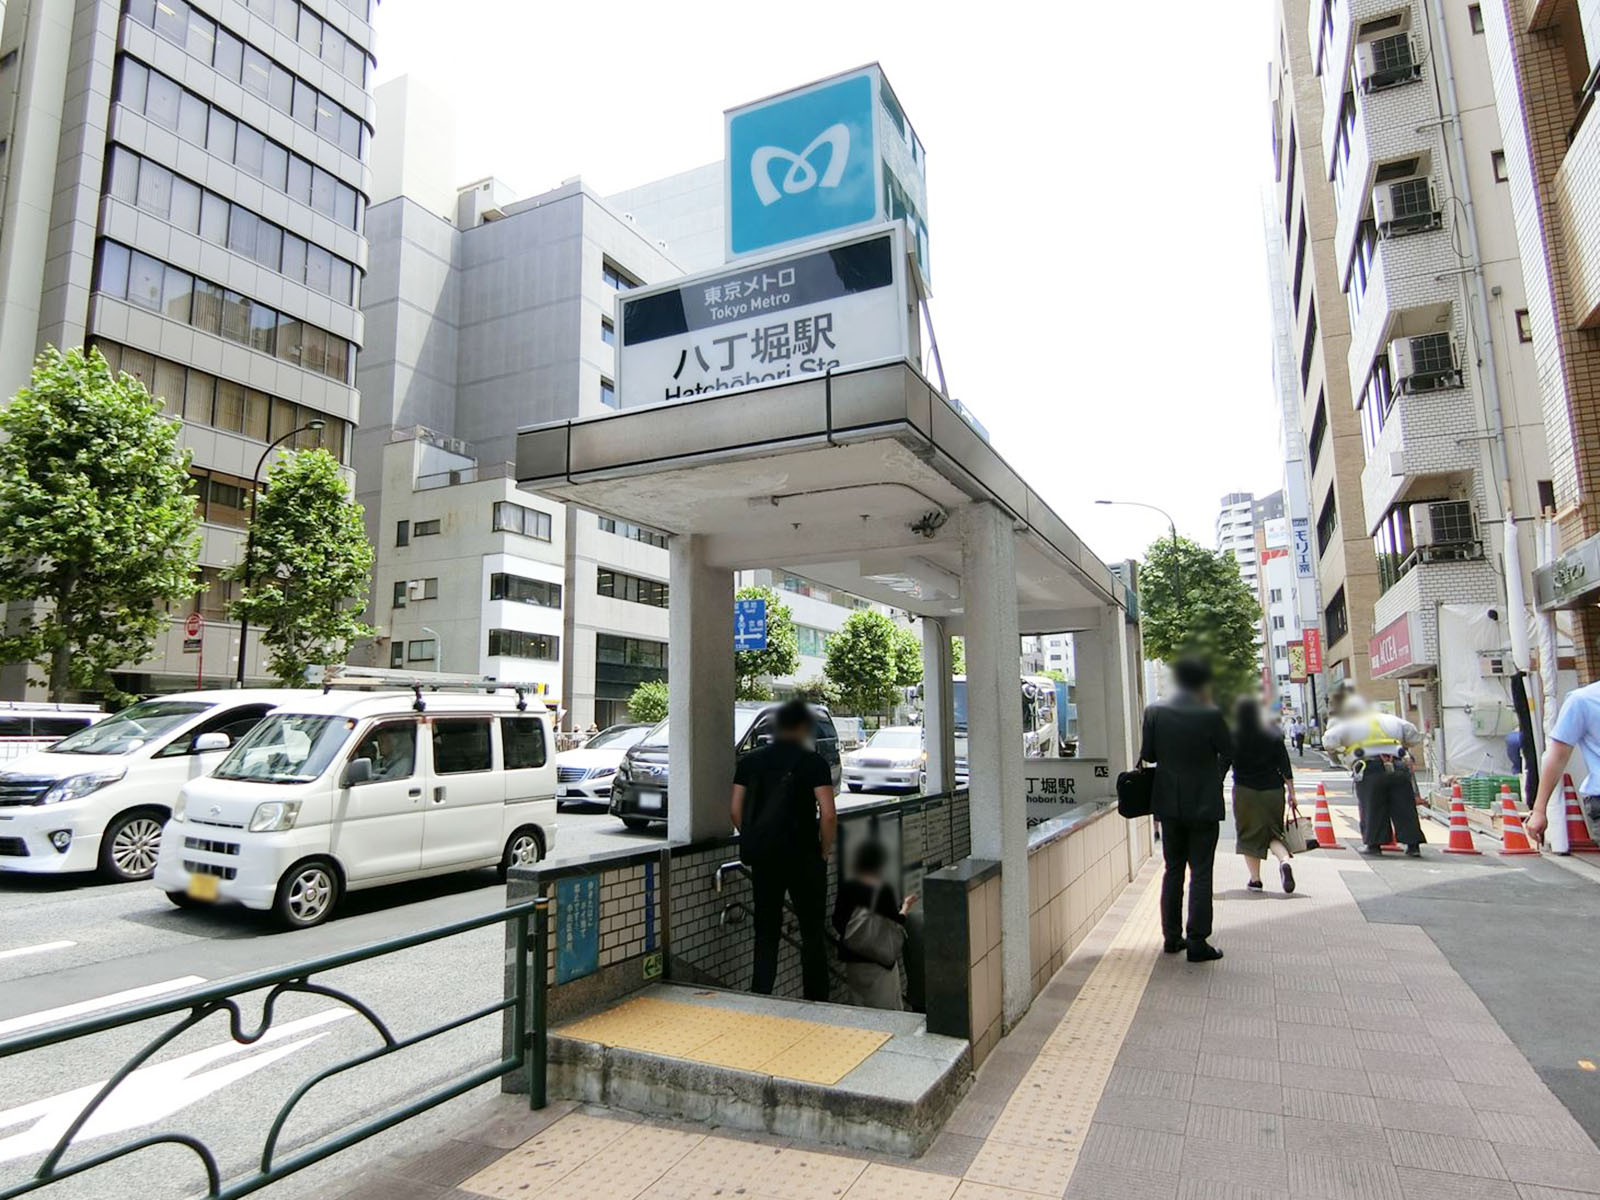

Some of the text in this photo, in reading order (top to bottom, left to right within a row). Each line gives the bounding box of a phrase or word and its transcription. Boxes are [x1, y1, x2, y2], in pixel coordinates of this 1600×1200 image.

[703, 267, 795, 306] 東京メトロ
[710, 293, 790, 320] Tokyo Metro
[673, 312, 836, 380] 八丁堀駅
